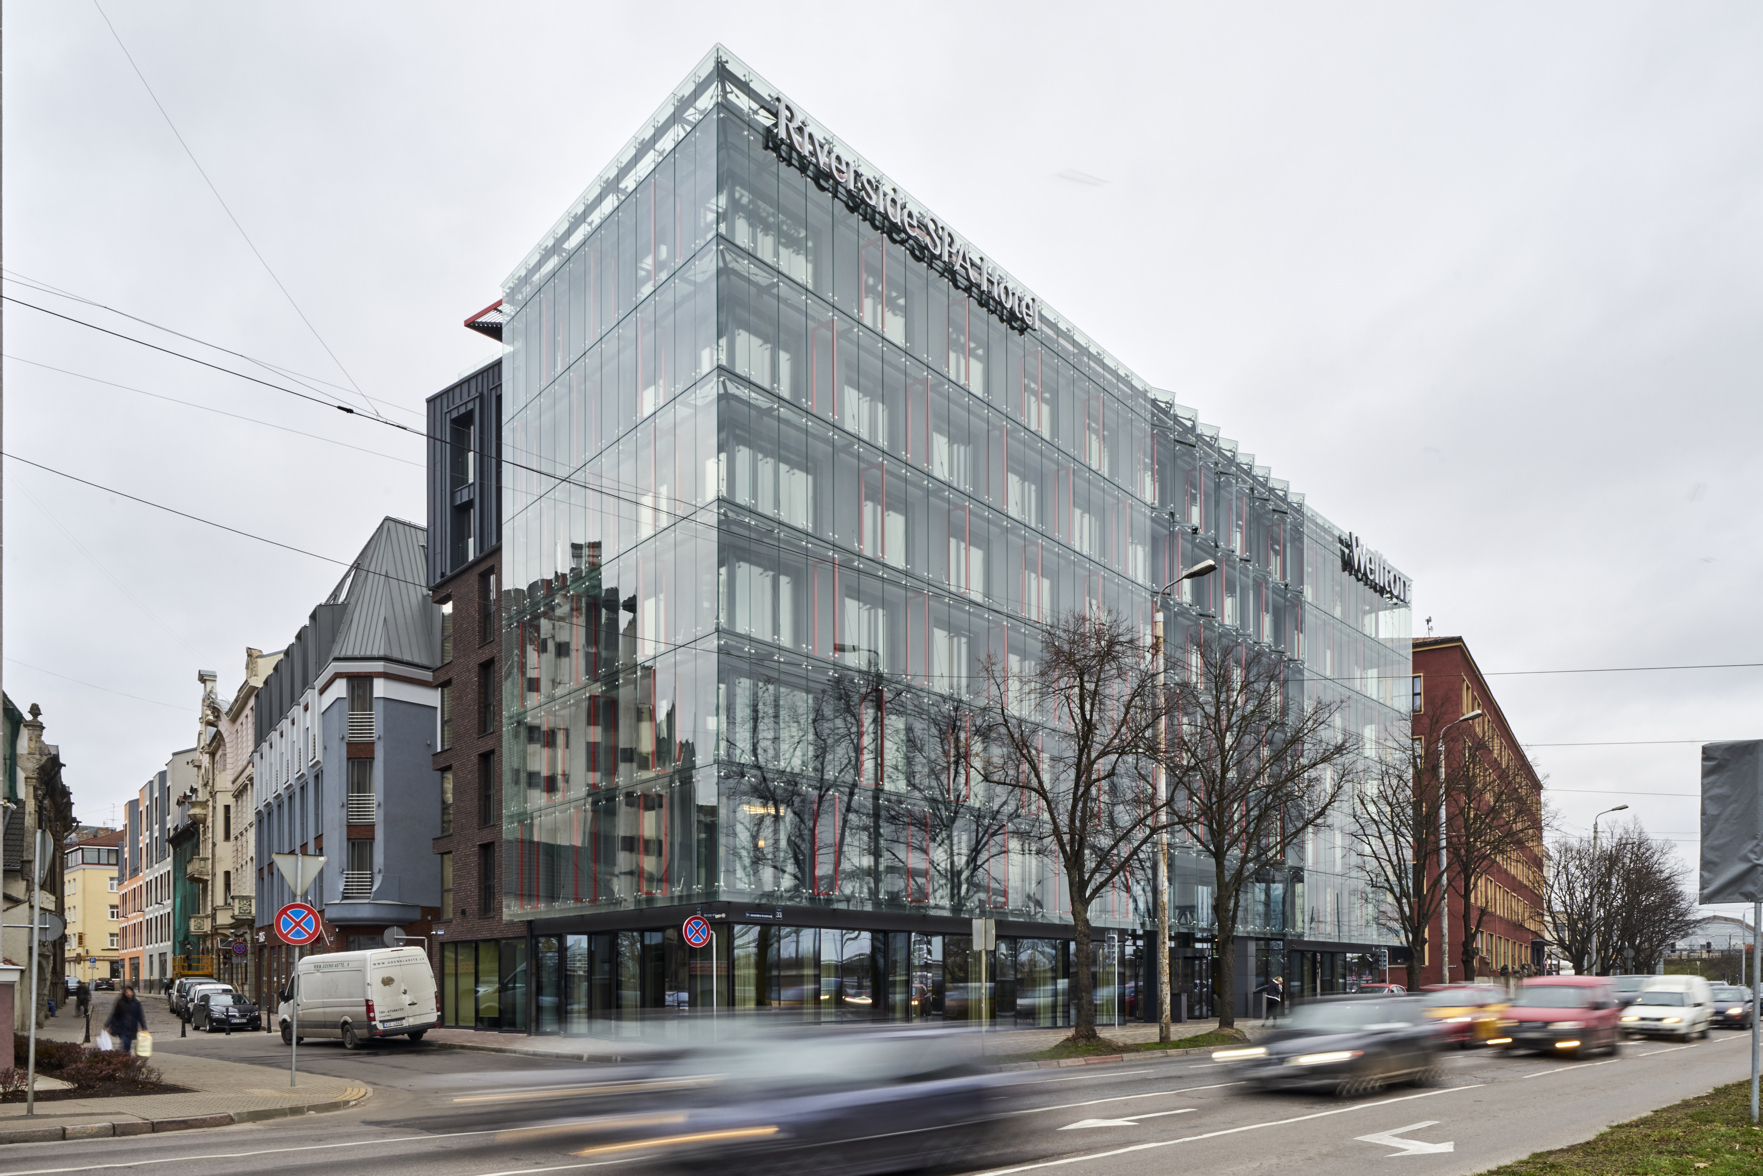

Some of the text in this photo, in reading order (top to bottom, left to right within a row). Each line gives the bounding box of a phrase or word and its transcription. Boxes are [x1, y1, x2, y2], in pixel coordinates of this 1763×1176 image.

[776, 97, 1039, 331] Riverside SPA Hotel
[1349, 531, 1407, 602] Wellton
